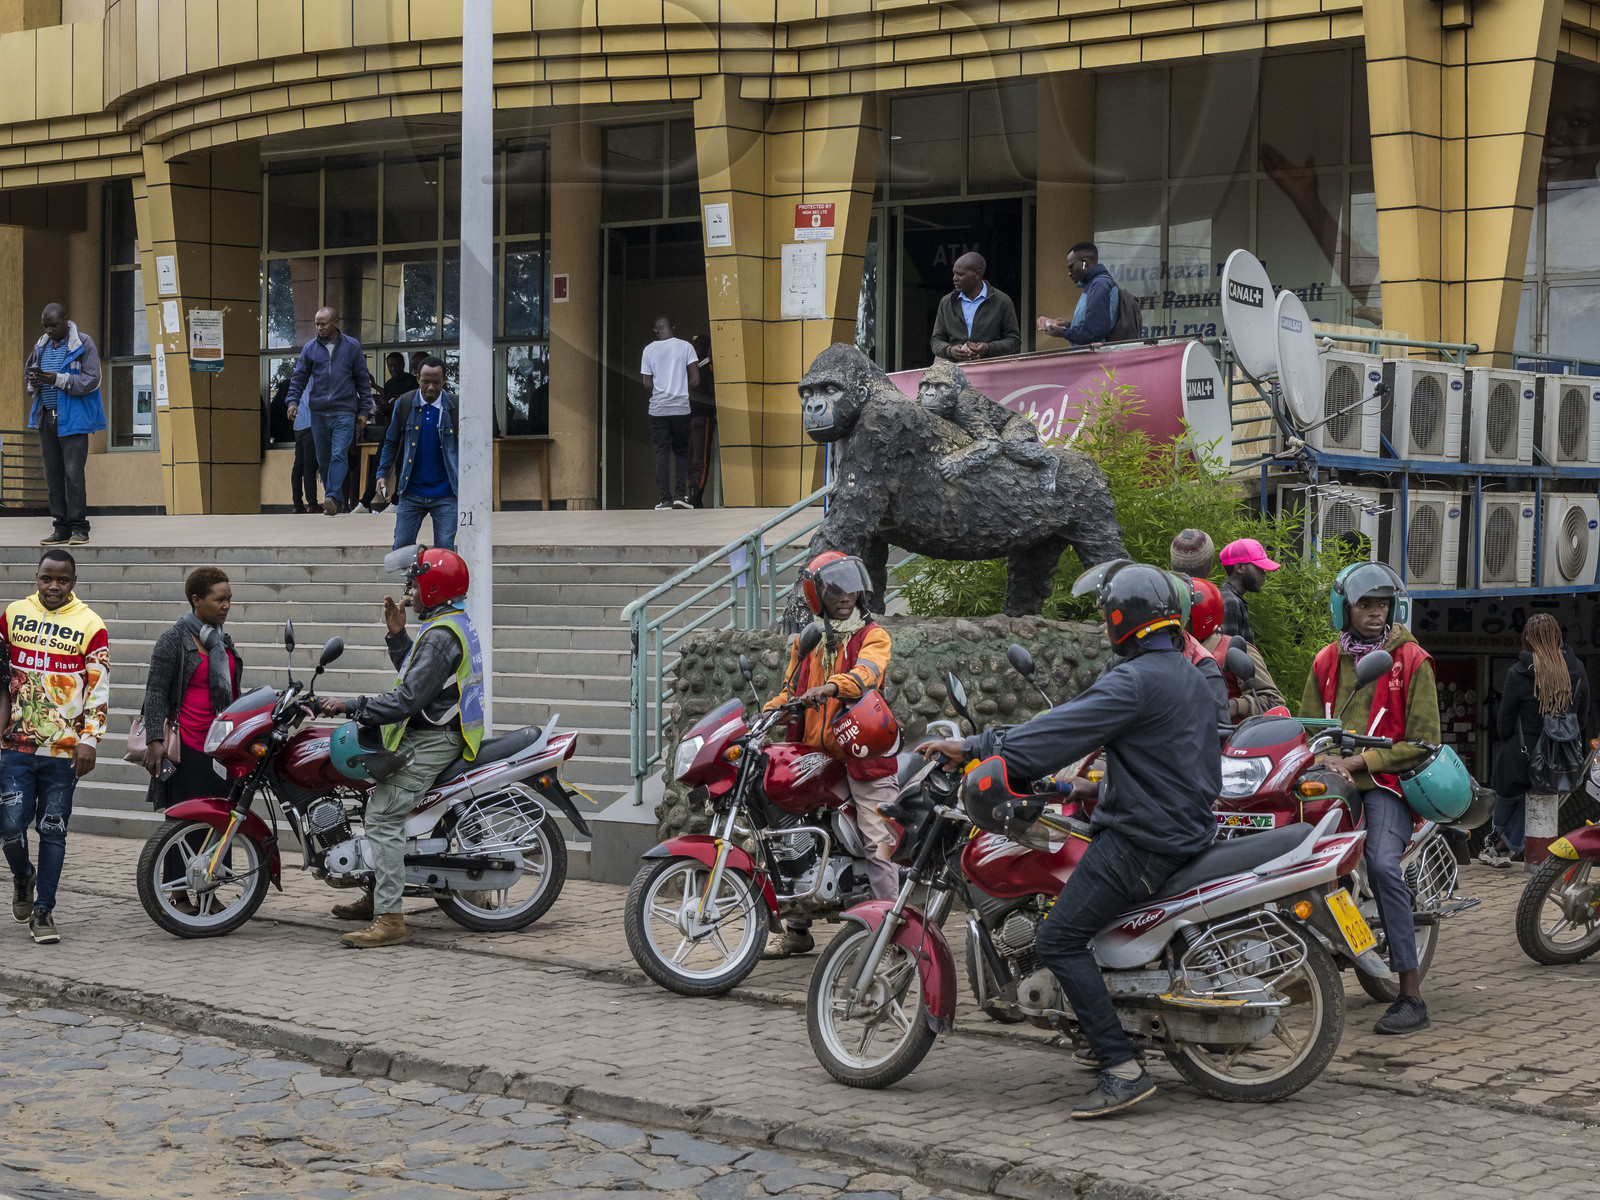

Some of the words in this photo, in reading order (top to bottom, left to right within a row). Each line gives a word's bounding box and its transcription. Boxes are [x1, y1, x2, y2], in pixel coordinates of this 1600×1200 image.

[1229, 282, 1262, 305] CANAL+
[460, 511, 474, 527] 21
[12, 615, 85, 646] Ramen
[49, 638, 77, 655] Soup
[17, 651, 51, 669] Beef
[1123, 909, 1163, 930] Victor
